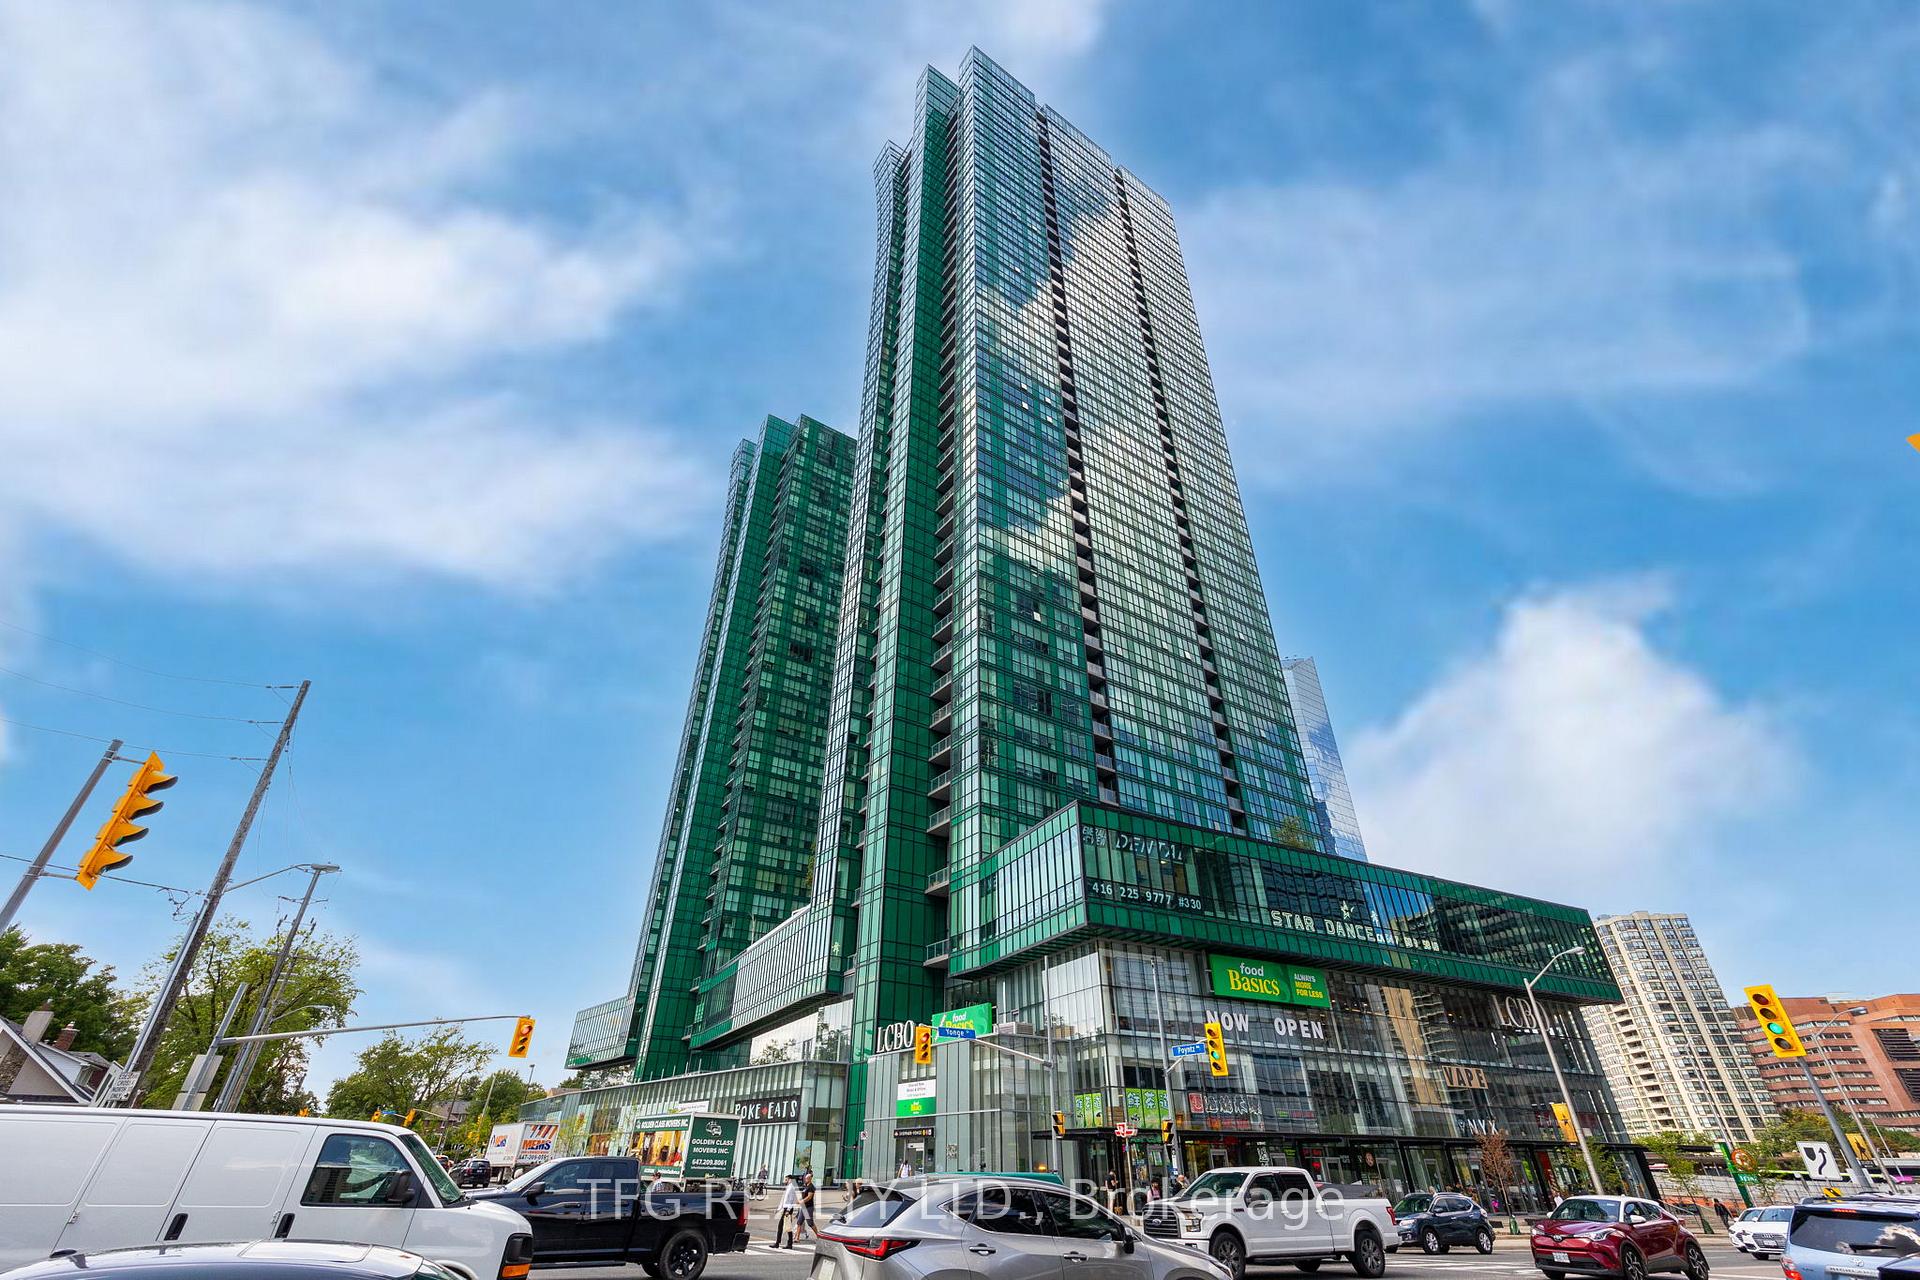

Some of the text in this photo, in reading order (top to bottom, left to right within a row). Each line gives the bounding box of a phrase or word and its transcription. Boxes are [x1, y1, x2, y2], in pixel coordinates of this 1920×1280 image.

[1092, 882, 1201, 910] 416 225 9777 #330
[1271, 910, 1316, 932] STAR
[1324, 919, 1377, 942] DANCE
[1240, 962, 1264, 977] food
[1294, 973, 1316, 983] ALWAYS
[1295, 981, 1312, 990] MORE
[1297, 989, 1323, 999] FOR LESS
[952, 1012, 967, 1023] food
[1206, 1009, 1324, 1039] NOW OPEN
[876, 1020, 915, 1053] LCBO
[946, 1028, 964, 1038] Yonge
[1178, 1046, 1195, 1056] Poyntz
[1443, 1066, 1486, 1088] VAPE
[735, 1100, 798, 1119] POKE EATS
[522, 1140, 551, 1150] MEMS
